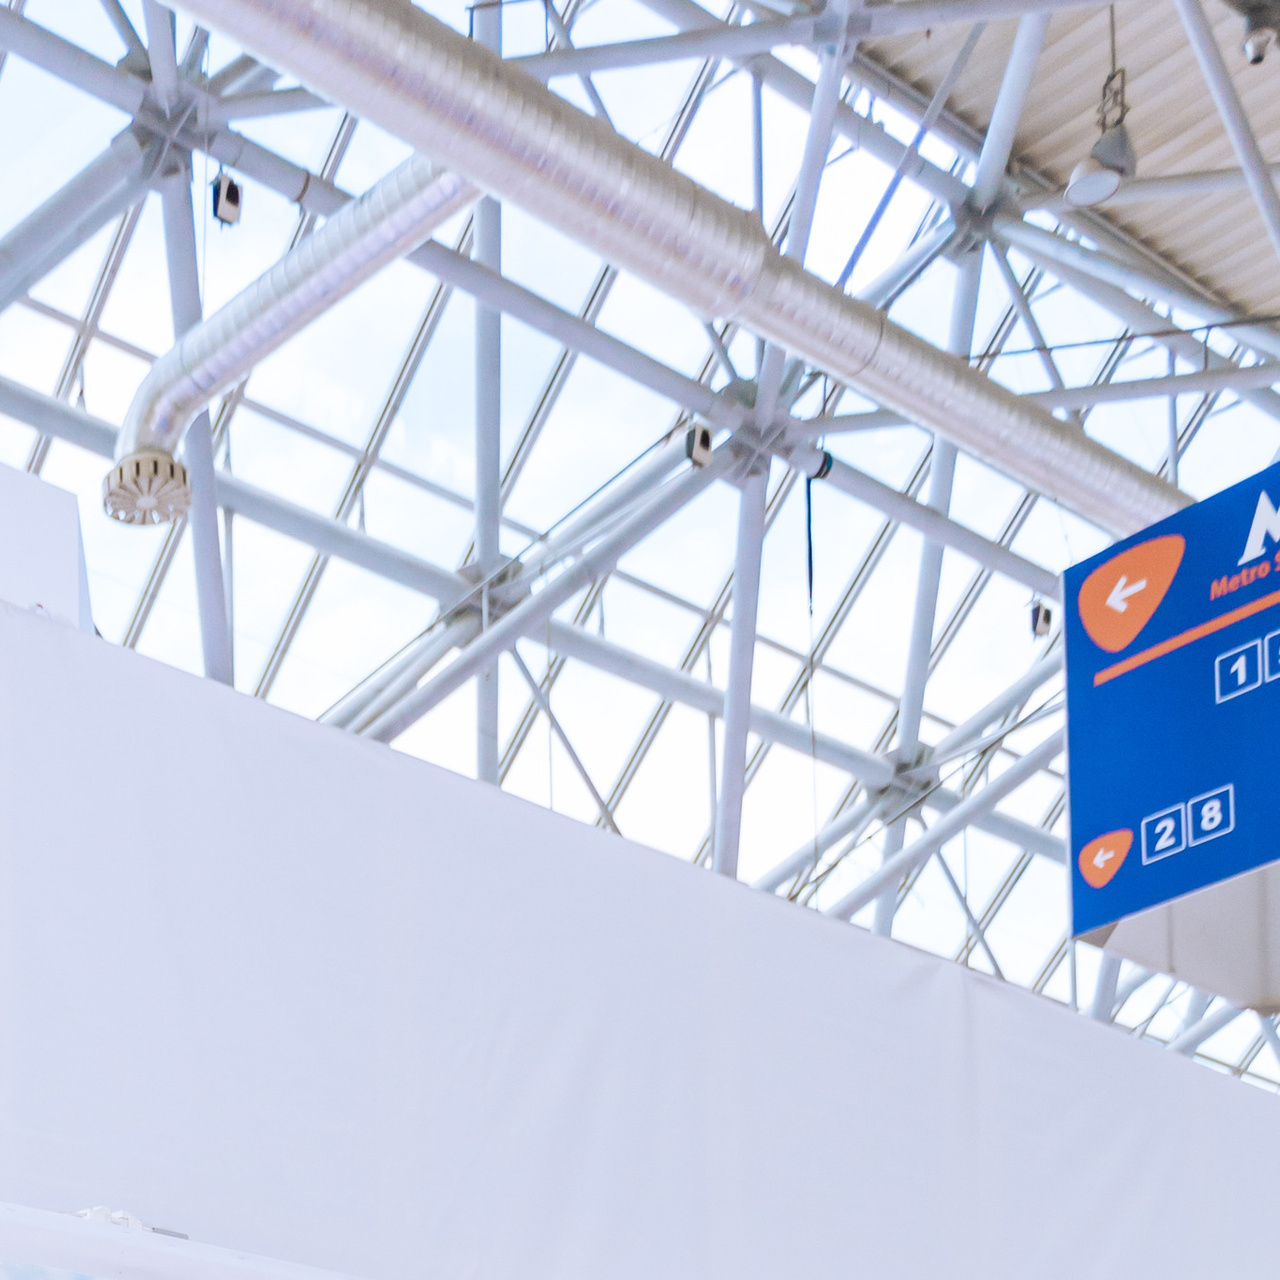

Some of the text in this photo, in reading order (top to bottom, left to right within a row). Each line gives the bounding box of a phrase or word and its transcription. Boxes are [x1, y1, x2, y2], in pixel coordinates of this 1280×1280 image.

[1210, 561, 1272, 602] Metro
[1230, 655, 1247, 686] 1
[1154, 799, 1222, 852] 2 8
